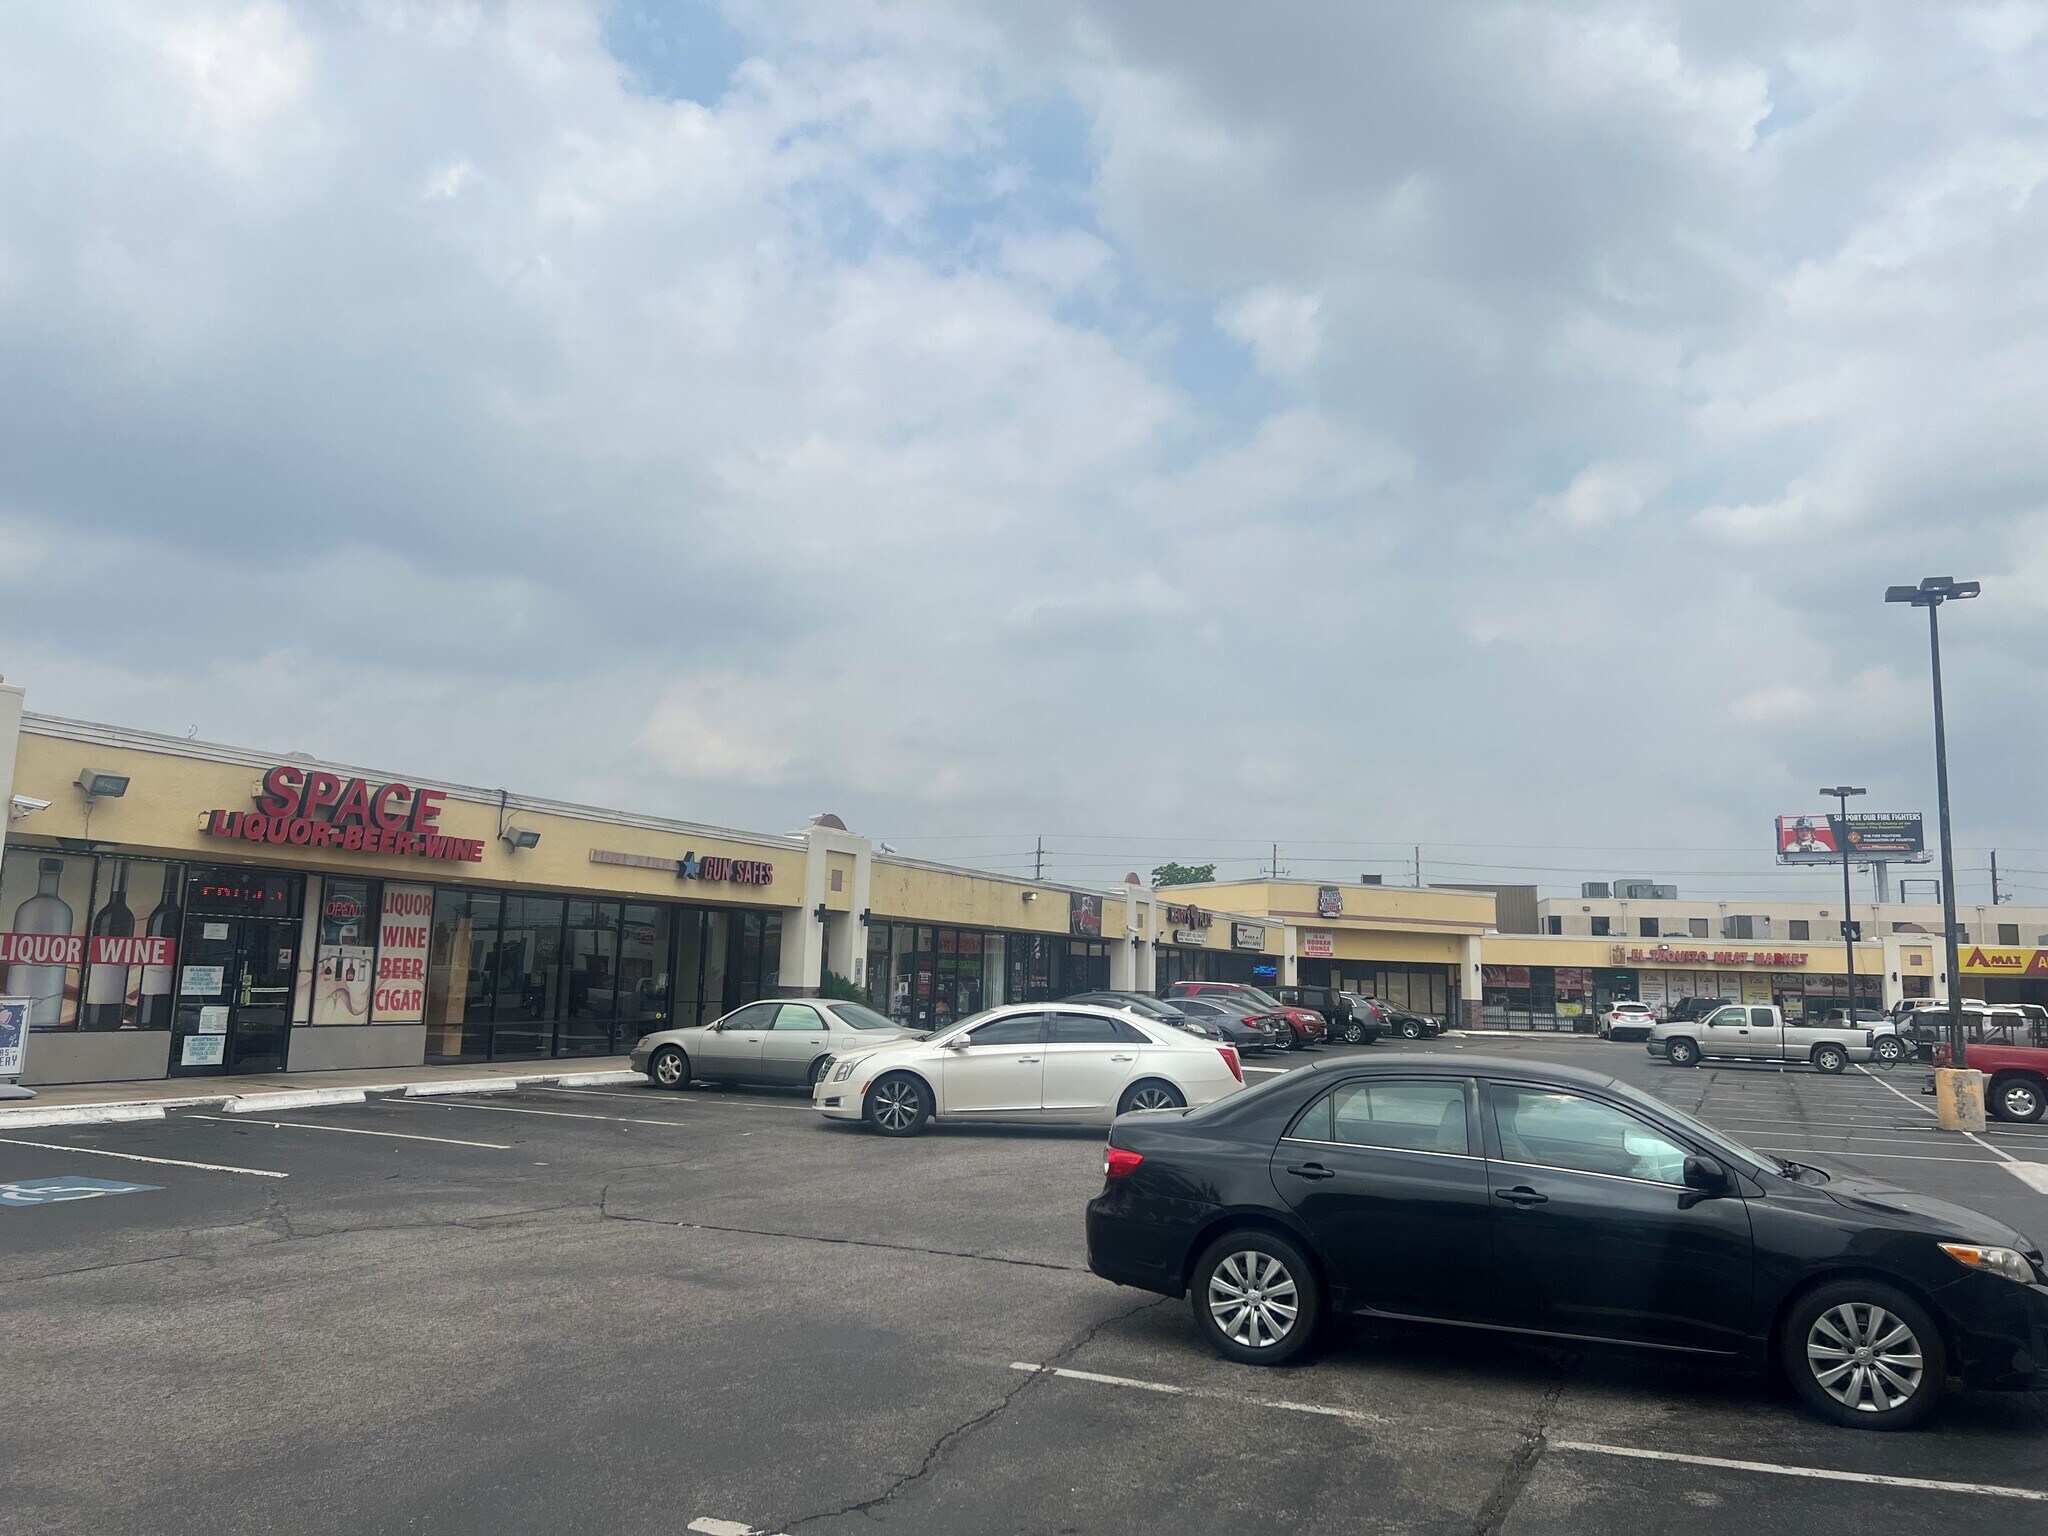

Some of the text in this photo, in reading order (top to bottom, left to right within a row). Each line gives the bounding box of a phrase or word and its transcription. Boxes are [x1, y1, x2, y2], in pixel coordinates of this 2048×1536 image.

[257, 766, 448, 834] SPACE
[208, 809, 486, 863] LIQUOR-BEER-WINE
[701, 857, 774, 885] GUN SAFES
[326, 902, 359, 918] OPEN
[382, 892, 432, 917] LIQUOR
[0, 935, 82, 963] LIQUOR
[383, 926, 427, 948] WINE
[100, 938, 166, 963] WINE
[1631, 949, 1809, 965] EL TAQUITO MEAT MARKET
[379, 957, 424, 979] BEER
[375, 989, 422, 1011] CIGAR
